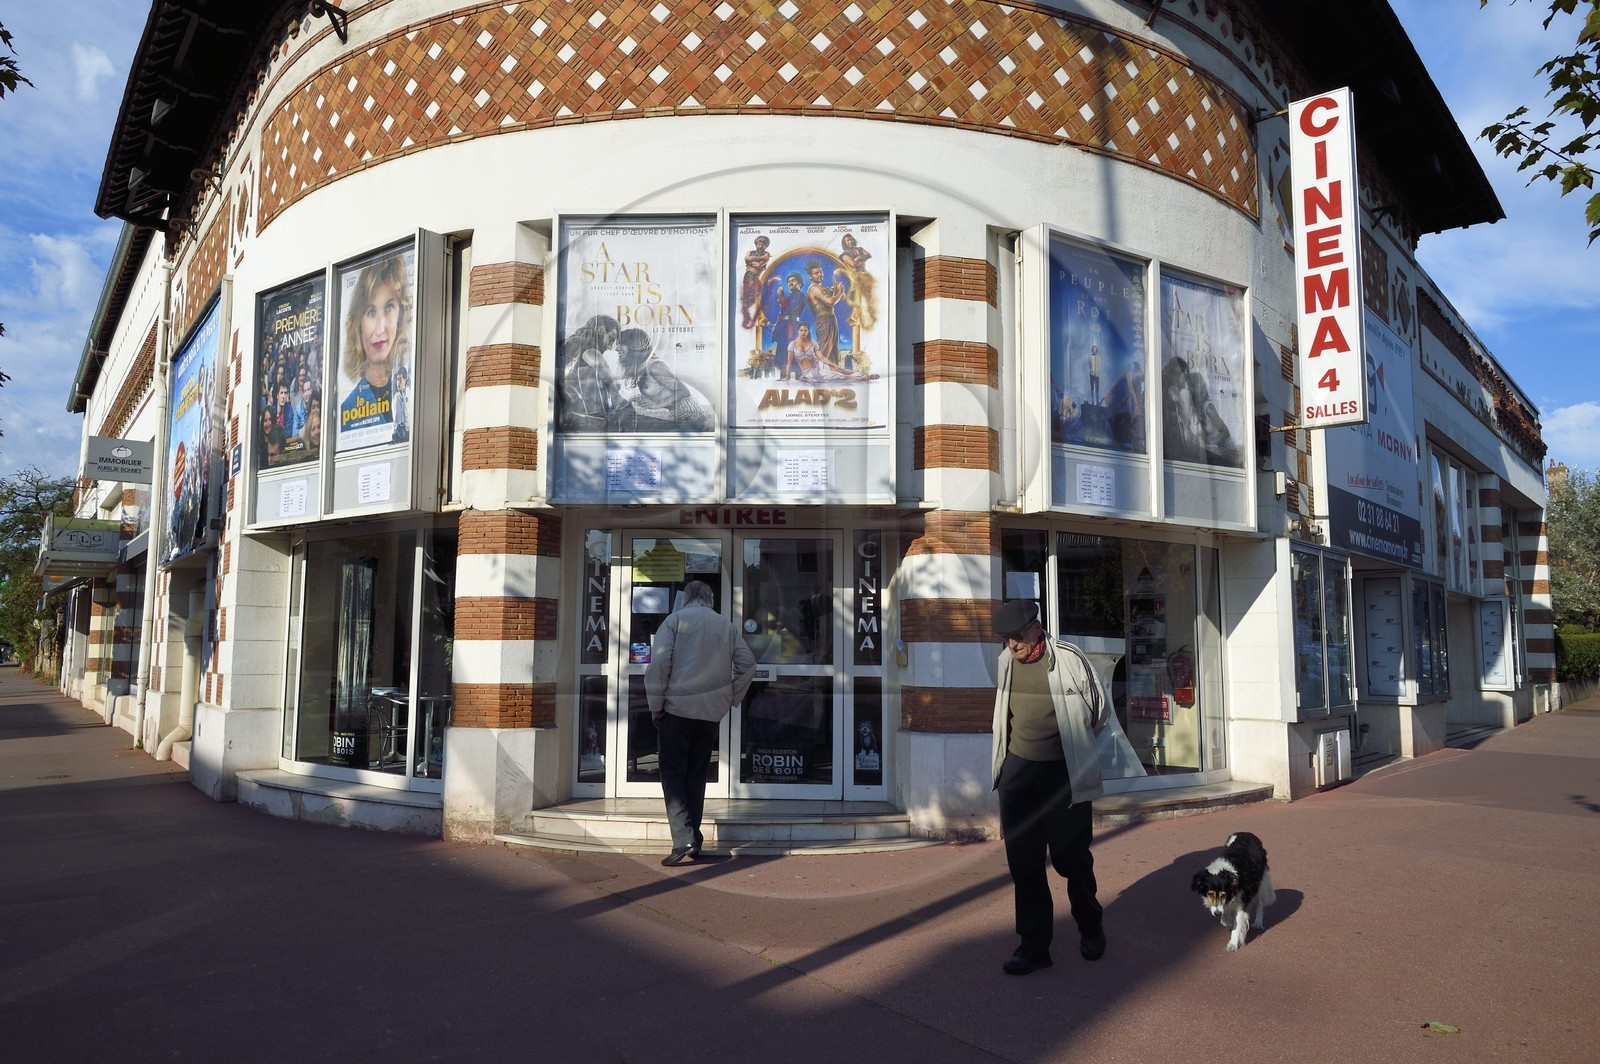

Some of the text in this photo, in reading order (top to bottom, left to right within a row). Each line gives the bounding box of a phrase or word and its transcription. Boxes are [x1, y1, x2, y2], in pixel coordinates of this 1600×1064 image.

[1299, 97, 1351, 359] CINEMA
[595, 242, 611, 262] A
[580, 262, 652, 284] STAR
[1060, 270, 1129, 298] PEUPLE
[635, 283, 662, 305] IS
[275, 306, 322, 335] PREMIÈRE
[614, 304, 695, 327] BORN
[1076, 300, 1110, 320] ROI
[1165, 309, 1205, 333] STAR
[1196, 333, 1212, 353] IS
[1185, 350, 1230, 376] BORN
[1317, 368, 1341, 392] 4
[356, 395, 365, 408] le
[757, 388, 858, 411] ALAD'2
[1306, 400, 1358, 419] SALLES
[342, 397, 390, 426] poulain
[1377, 428, 1412, 463] MORNY
[98, 456, 142, 467] IMMOBILIER
[1357, 499, 1367, 523] 02
[1366, 503, 1375, 526] 31
[1375, 507, 1385, 529] 88
[1392, 513, 1400, 535] 21
[1348, 529, 1408, 563] www.cinemamorny.fr
[585, 541, 607, 652] CINEMA
[857, 541, 878, 652] CINEMA
[752, 754, 804, 767] ROBIN
[752, 765, 804, 775] DES BOIS
